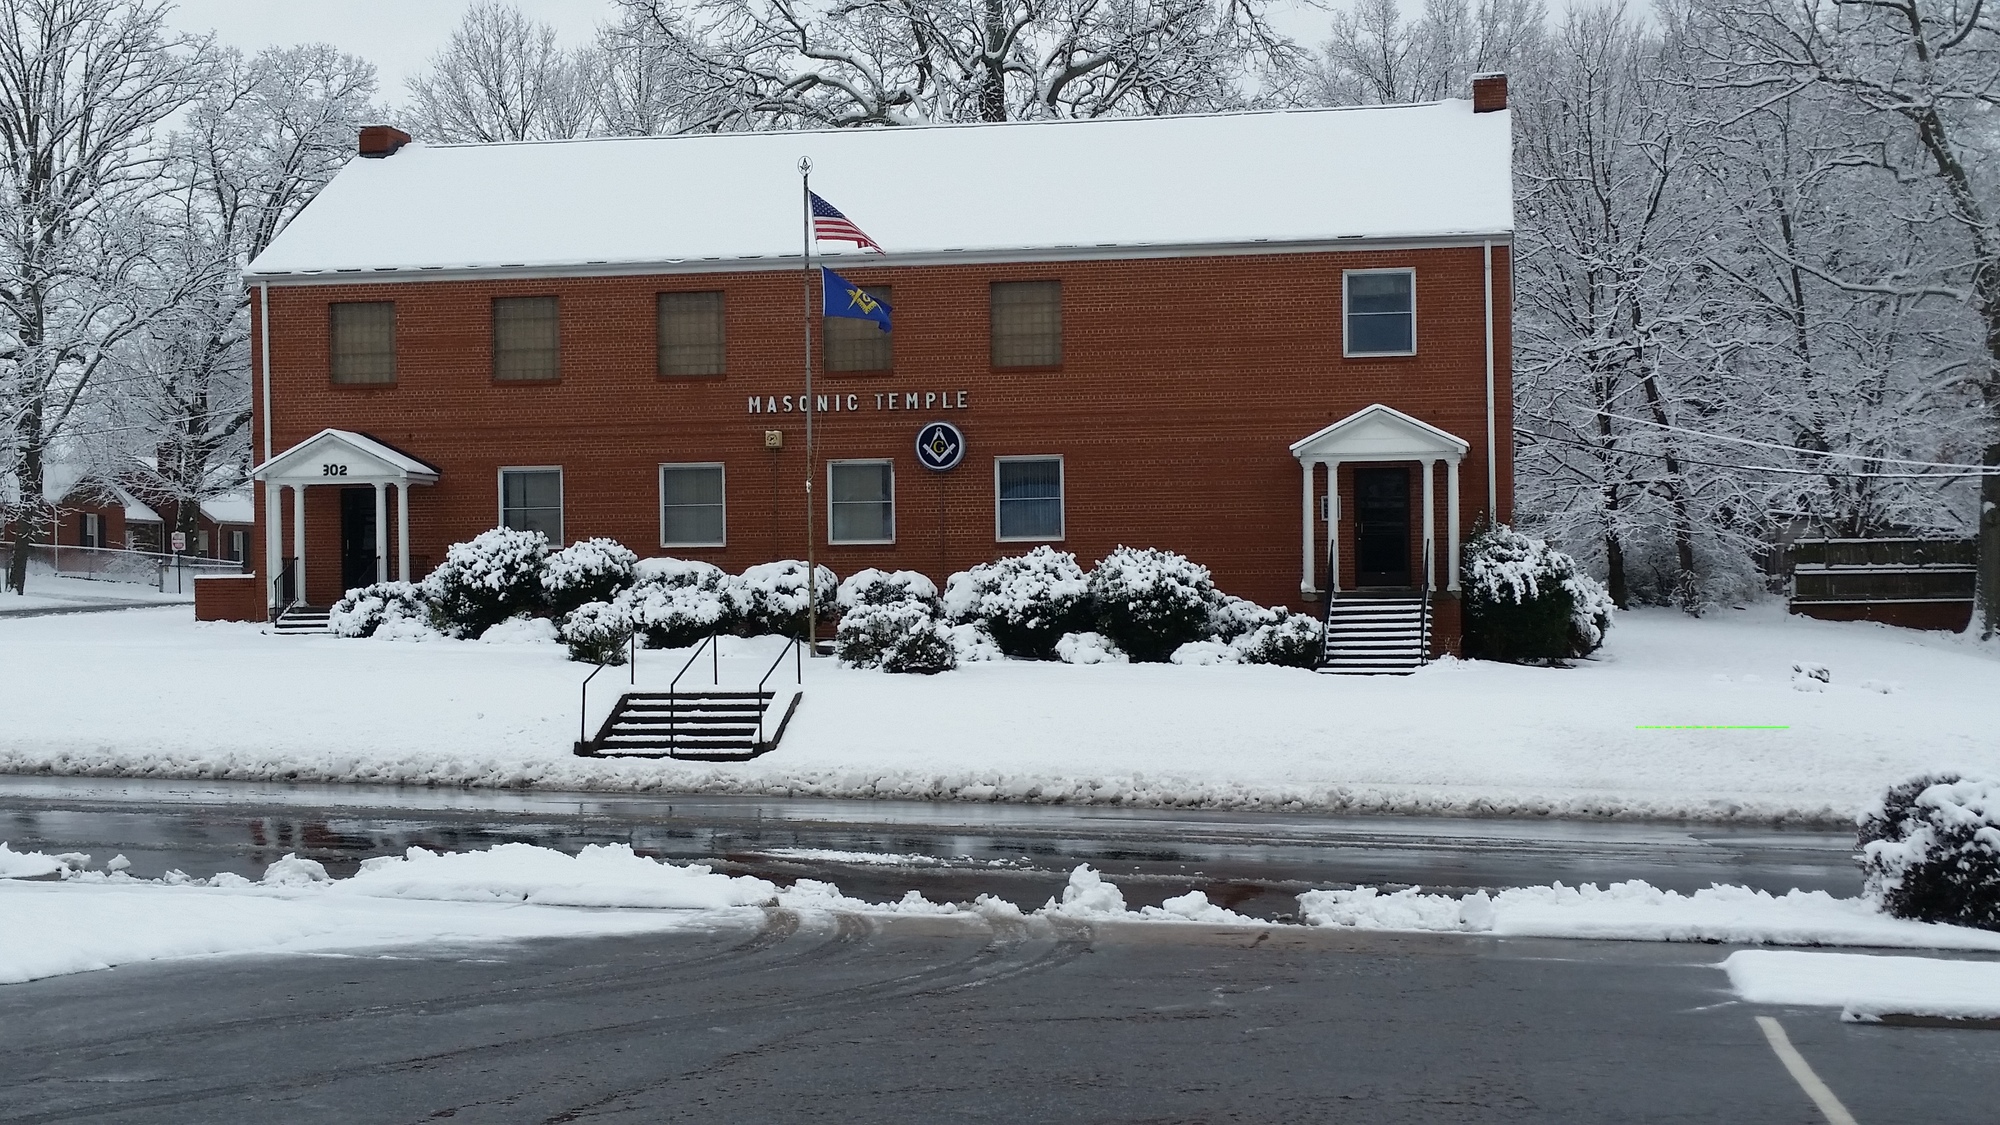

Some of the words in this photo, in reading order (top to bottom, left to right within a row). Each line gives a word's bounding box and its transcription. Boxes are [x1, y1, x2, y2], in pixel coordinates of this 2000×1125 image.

[748, 394, 858, 413] MASONIC
[874, 391, 968, 410] TEMPLE
[933, 440, 945, 453] G
[323, 464, 348, 476] 302
